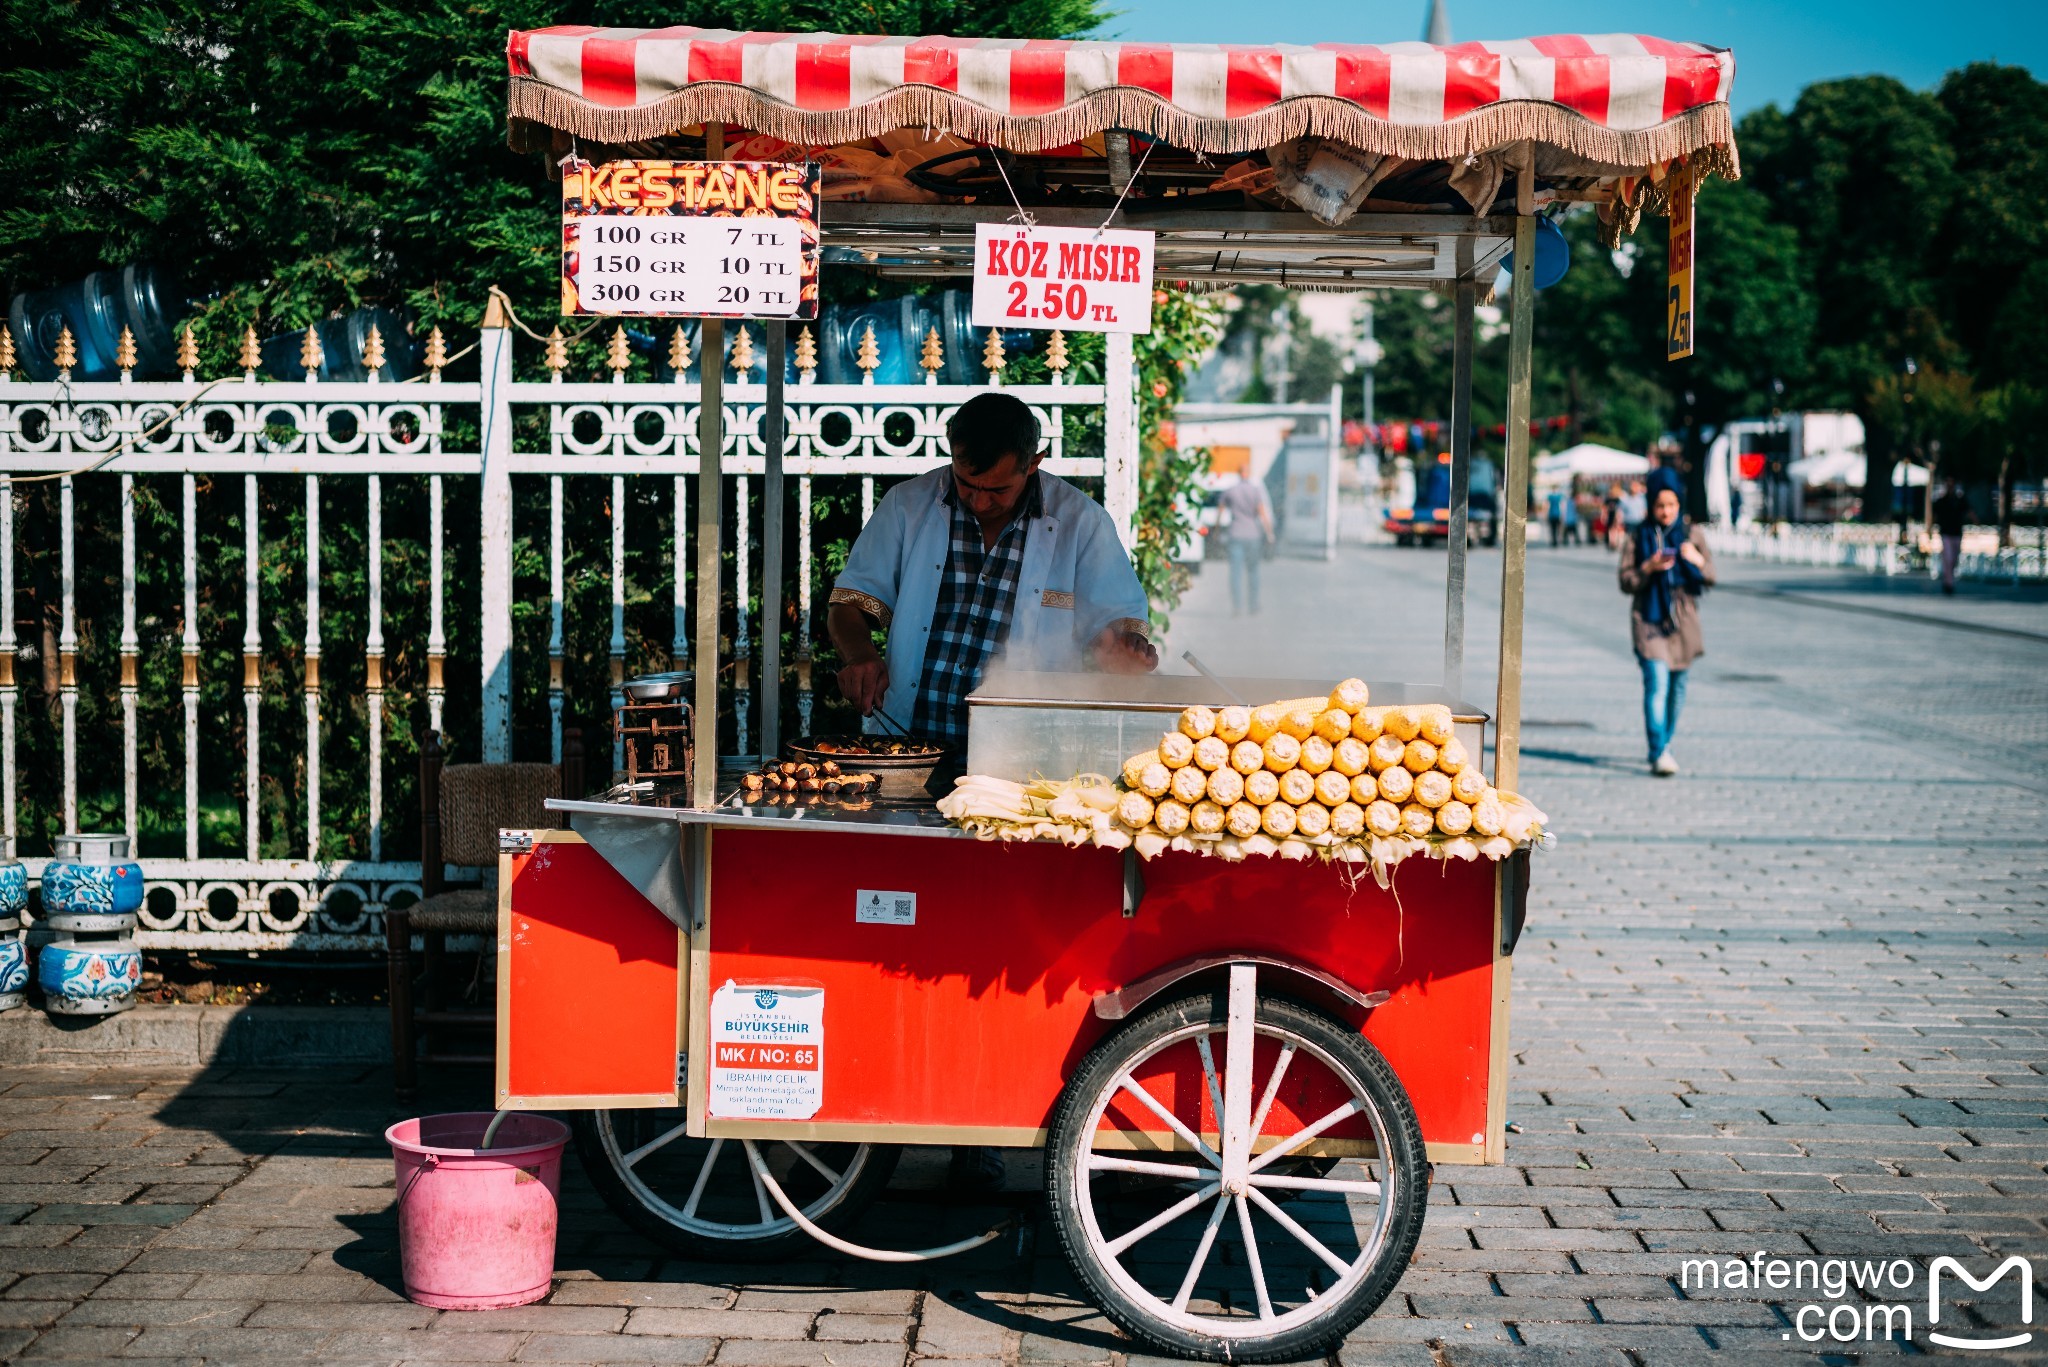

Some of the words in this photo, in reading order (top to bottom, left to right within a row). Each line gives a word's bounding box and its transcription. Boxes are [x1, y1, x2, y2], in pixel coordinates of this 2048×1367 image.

[581, 167, 800, 210] KESTANE
[1672, 178, 1690, 228] SÜT
[593, 226, 641, 244] 100
[650, 231, 687, 245] GR
[727, 228, 743, 246] 7
[751, 233, 785, 246] TL
[1669, 228, 1691, 276] MISIR
[593, 255, 641, 273] 150
[650, 260, 686, 274] GR
[719, 257, 750, 275] 10
[759, 262, 793, 276] TL
[987, 231, 1049, 279] KÖZ
[1057, 242, 1141, 283] MISIR
[591, 284, 640, 302] 300
[649, 289, 686, 303] GR
[717, 286, 749, 304] 20
[758, 291, 792, 304] TL
[1006, 281, 1088, 320] 2.50
[1091, 305, 1118, 322] TL
[720, 1047, 746, 1062] MK
[749, 1048, 756, 1062] /
[759, 1048, 790, 1064] NO:
[794, 1049, 814, 1064] 65
